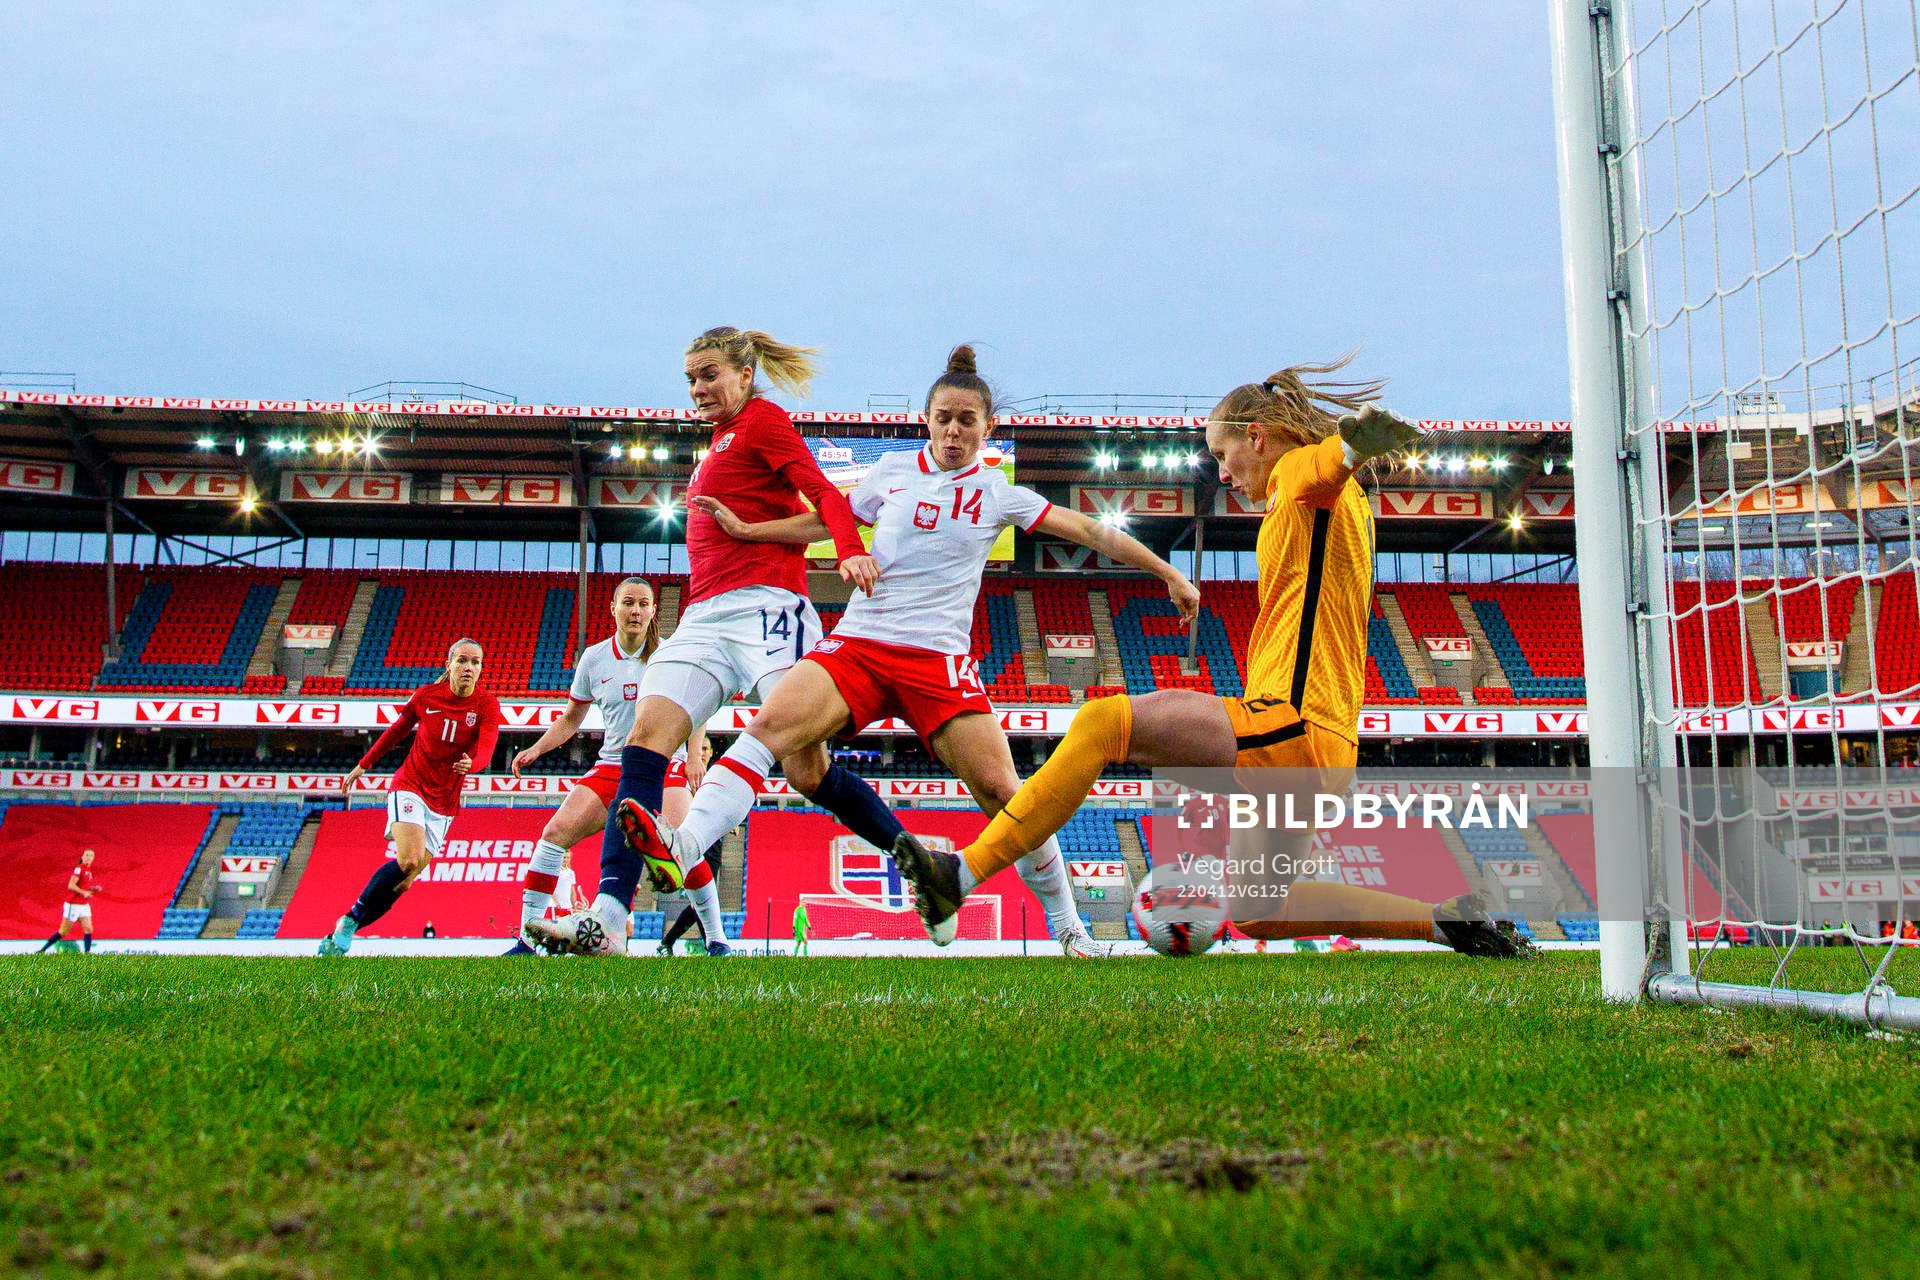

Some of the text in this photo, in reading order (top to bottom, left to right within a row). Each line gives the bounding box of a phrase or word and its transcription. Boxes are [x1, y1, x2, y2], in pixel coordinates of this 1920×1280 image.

[19, 392, 56, 403] VG
[68, 394, 104, 405] VG
[116, 396, 152, 407] VG
[164, 398, 200, 408] VG
[212, 399, 248, 409] VG
[260, 400, 296, 410] VG
[307, 401, 343, 411] VG
[355, 402, 391, 412] VG
[402, 403, 438, 413] VG
[450, 404, 486, 414] VG
[498, 405, 533, 415] VG
[545, 406, 580, 416] VG
[592, 407, 627, 417] VG
[639, 408, 674, 417] VG
[826, 412, 861, 421] VG
[872, 414, 907, 422] VG
[1011, 416, 1046, 425] VG
[1057, 416, 1091, 425] VG
[1103, 416, 1137, 425] VG
[1149, 417, 1183, 426] VG
[1419, 421, 1453, 430] VG
[1464, 421, 1497, 430] VG
[1508, 422, 1542, 430] VG
[821, 451, 848, 459] 45:54
[0, 462, 62, 491] G
[138, 470, 246, 497] VG
[293, 475, 401, 500] VG
[453, 477, 560, 503] VG
[1080, 488, 1182, 513] VG
[1700, 484, 1802, 513] VG
[1878, 478, 1920, 505] V
[950, 486, 983, 524] 14
[1227, 490, 1268, 516] V
[1382, 491, 1482, 515] VG
[1526, 493, 1574, 516] V
[286, 626, 335, 639] VG
[758, 608, 791, 641] 14
[1047, 636, 1094, 648] VG
[1424, 638, 1471, 651] VG
[1788, 644, 1840, 656] VG
[945, 655, 979, 688] 14
[13, 699, 99, 720] VG
[136, 701, 219, 721] VG
[257, 703, 340, 723] VG
[1360, 713, 1390, 732] G
[1425, 713, 1502, 732] VG
[1537, 713, 1589, 732] V
[1764, 709, 1844, 730] VG
[1882, 706, 1920, 728] V
[441, 718, 458, 742] 11
[13, 771, 71, 787] VG
[83, 773, 139, 788] VG
[152, 774, 208, 788] VG
[220, 775, 276, 789] VG
[288, 776, 344, 789] VG
[491, 778, 547, 792] VG
[891, 781, 945, 795] VG
[1093, 782, 1142, 796] VG
[1410, 782, 1461, 796] VG
[1537, 783, 1588, 796] VG
[222, 859, 275, 872] VG
[1071, 863, 1123, 877] VG
[1490, 862, 1540, 876] VG
[1819, 881, 1882, 896] VG
